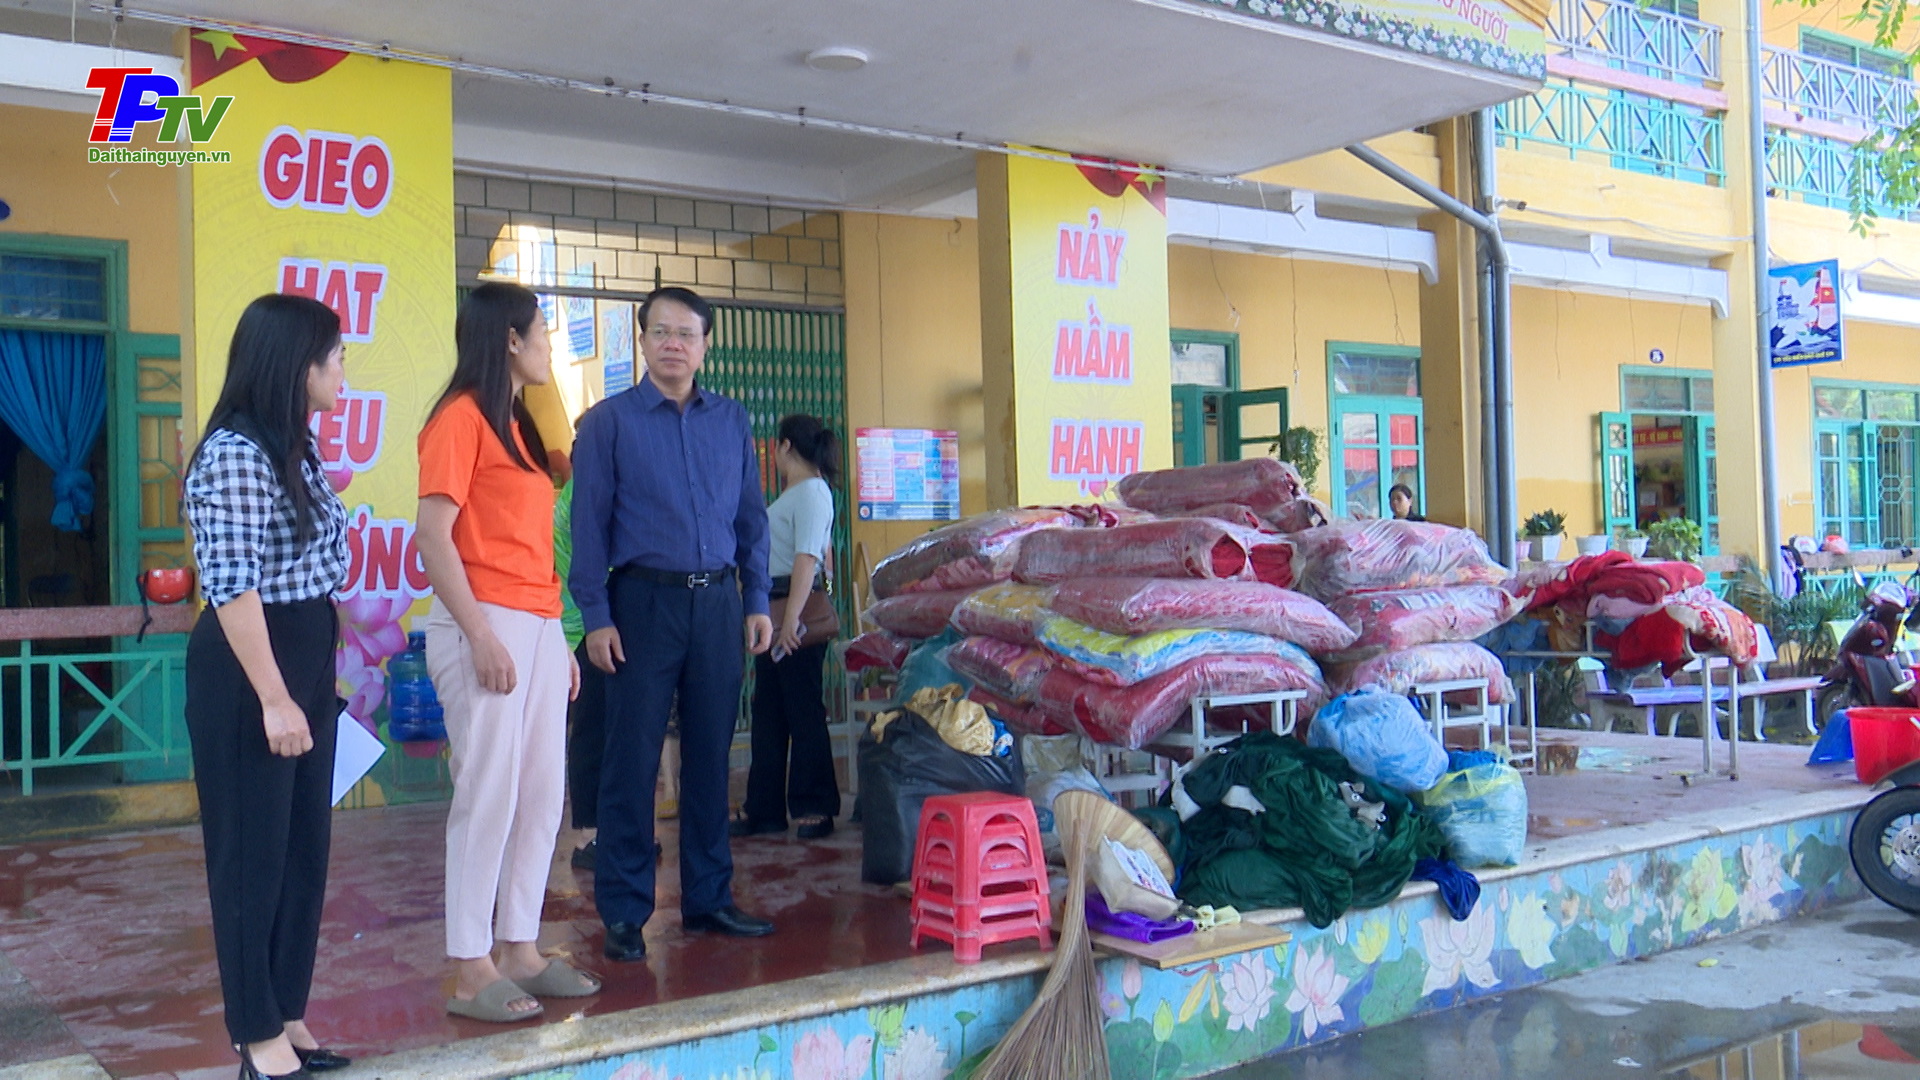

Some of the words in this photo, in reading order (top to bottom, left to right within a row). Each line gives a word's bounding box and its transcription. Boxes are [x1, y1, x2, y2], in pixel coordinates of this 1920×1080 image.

[262, 132, 391, 211] GIEO
[1056, 211, 1127, 285] NẢY
[1052, 301, 1131, 380] MẦM
[1050, 423, 1142, 491] HẠNH
